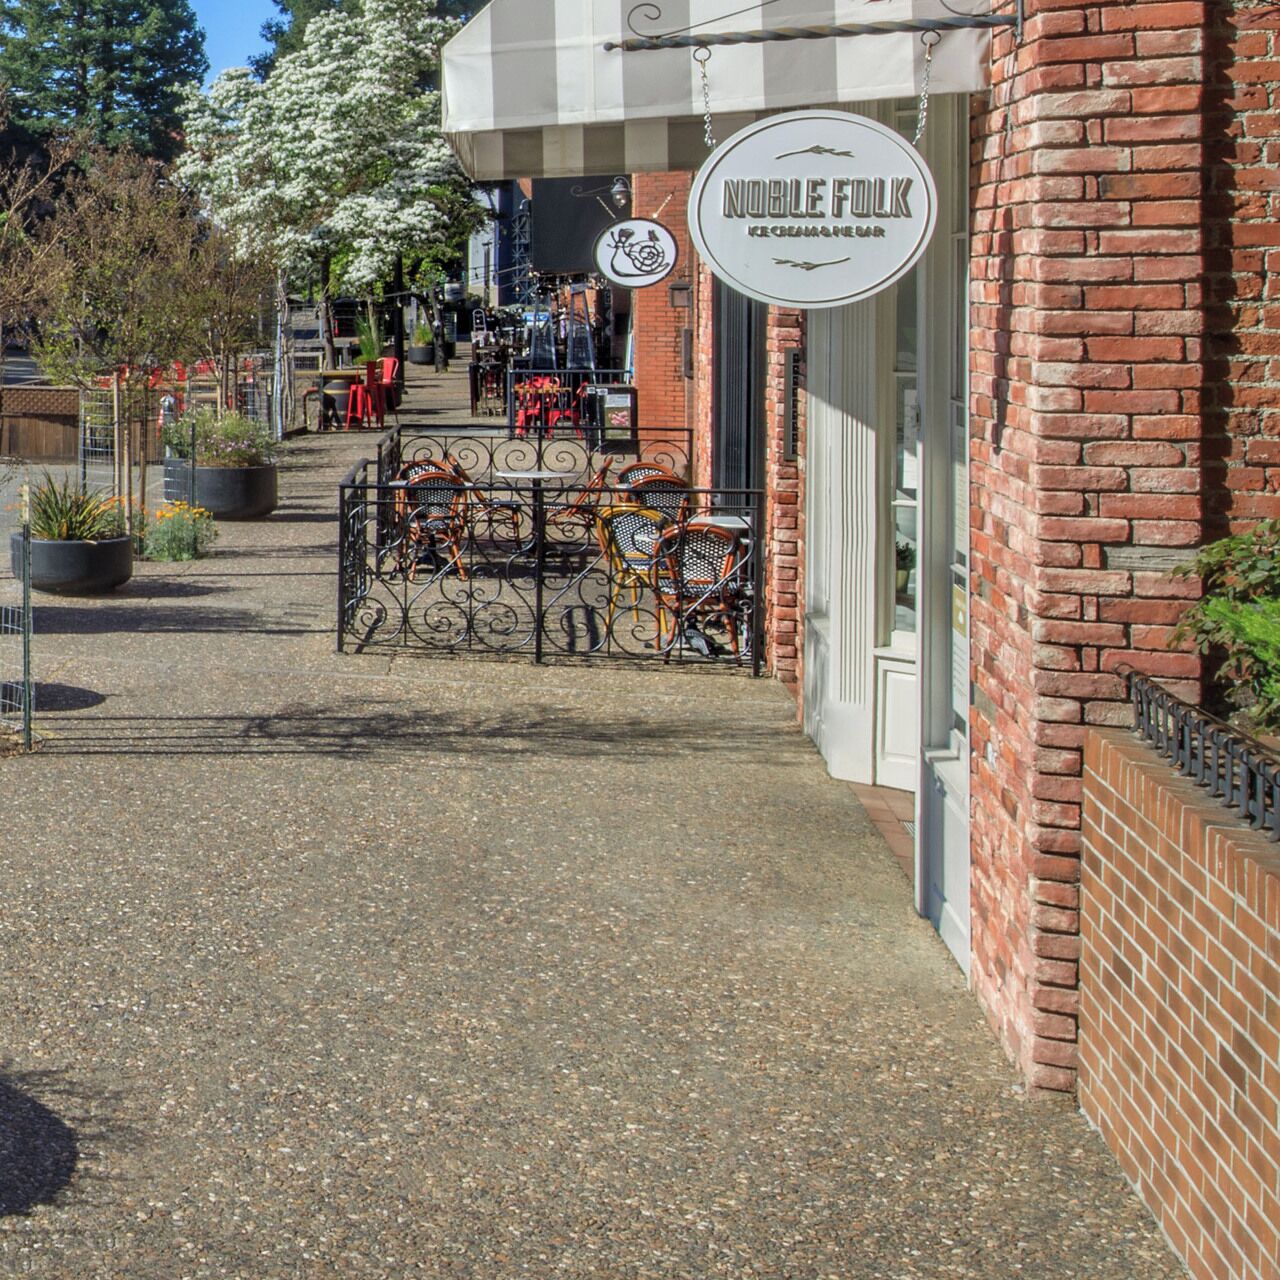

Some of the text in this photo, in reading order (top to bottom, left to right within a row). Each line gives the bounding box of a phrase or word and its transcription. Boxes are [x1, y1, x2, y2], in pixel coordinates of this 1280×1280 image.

[723, 177, 913, 218] NOBLE FOLK
[748, 225, 886, 238] ICE CREAM & PIE BAR
